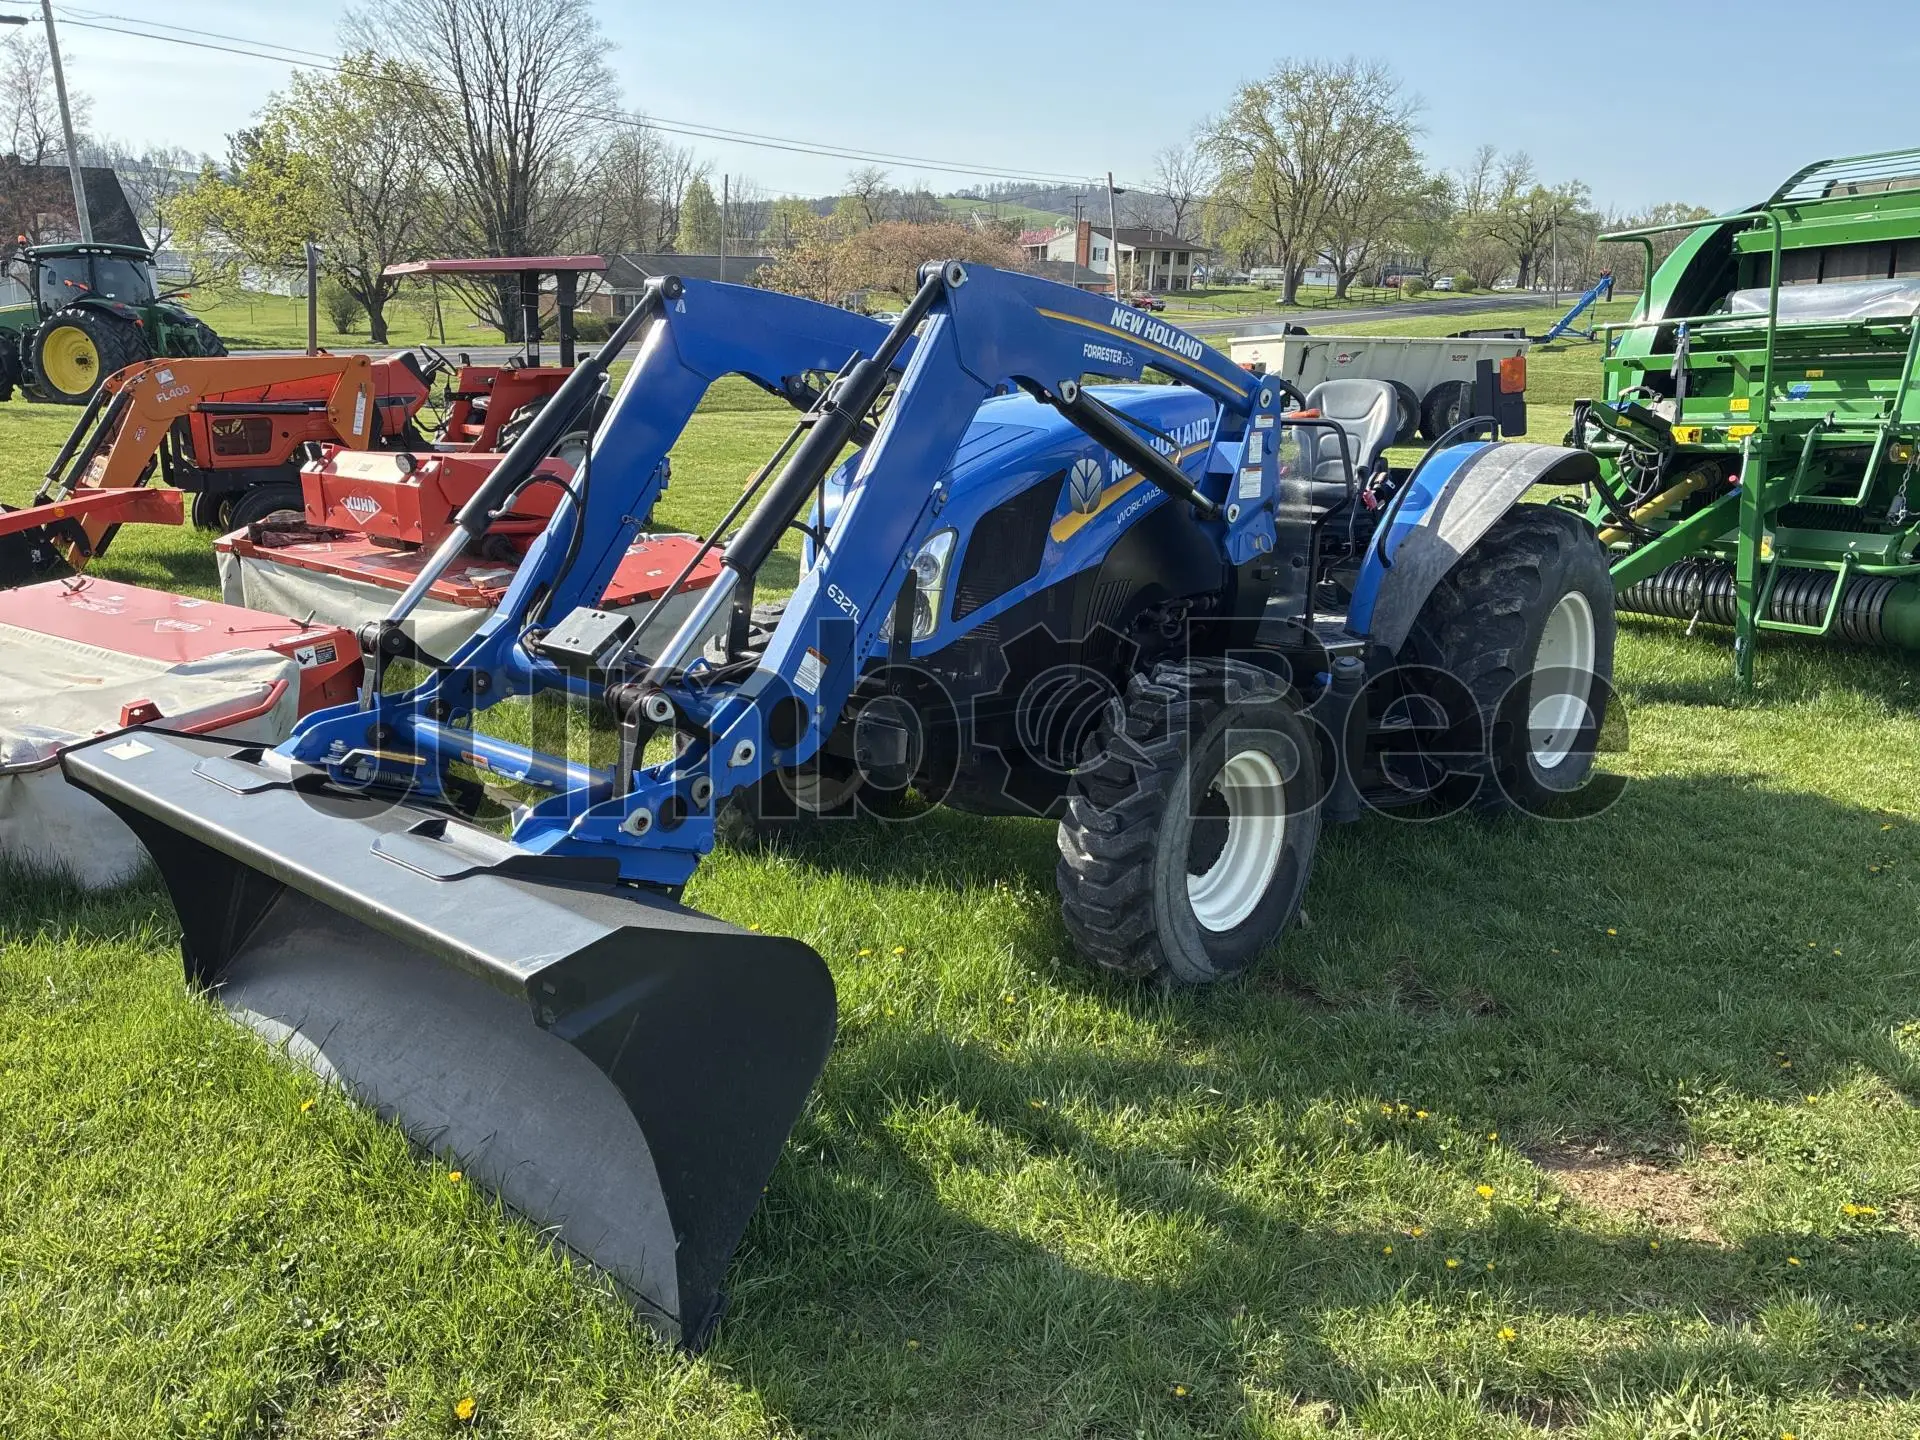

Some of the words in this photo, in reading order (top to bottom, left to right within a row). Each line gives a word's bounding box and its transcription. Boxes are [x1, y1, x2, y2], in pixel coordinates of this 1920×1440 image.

[1110, 307, 1145, 335] NEW
[1144, 320, 1203, 361] HOLLAND
[1083, 343, 1122, 364] FORRESTER
[155, 385, 191, 403] FL400
[346, 496, 377, 513] KUHN
[1116, 486, 1164, 524] WORKMAS
[827, 583, 860, 625] 632TL
